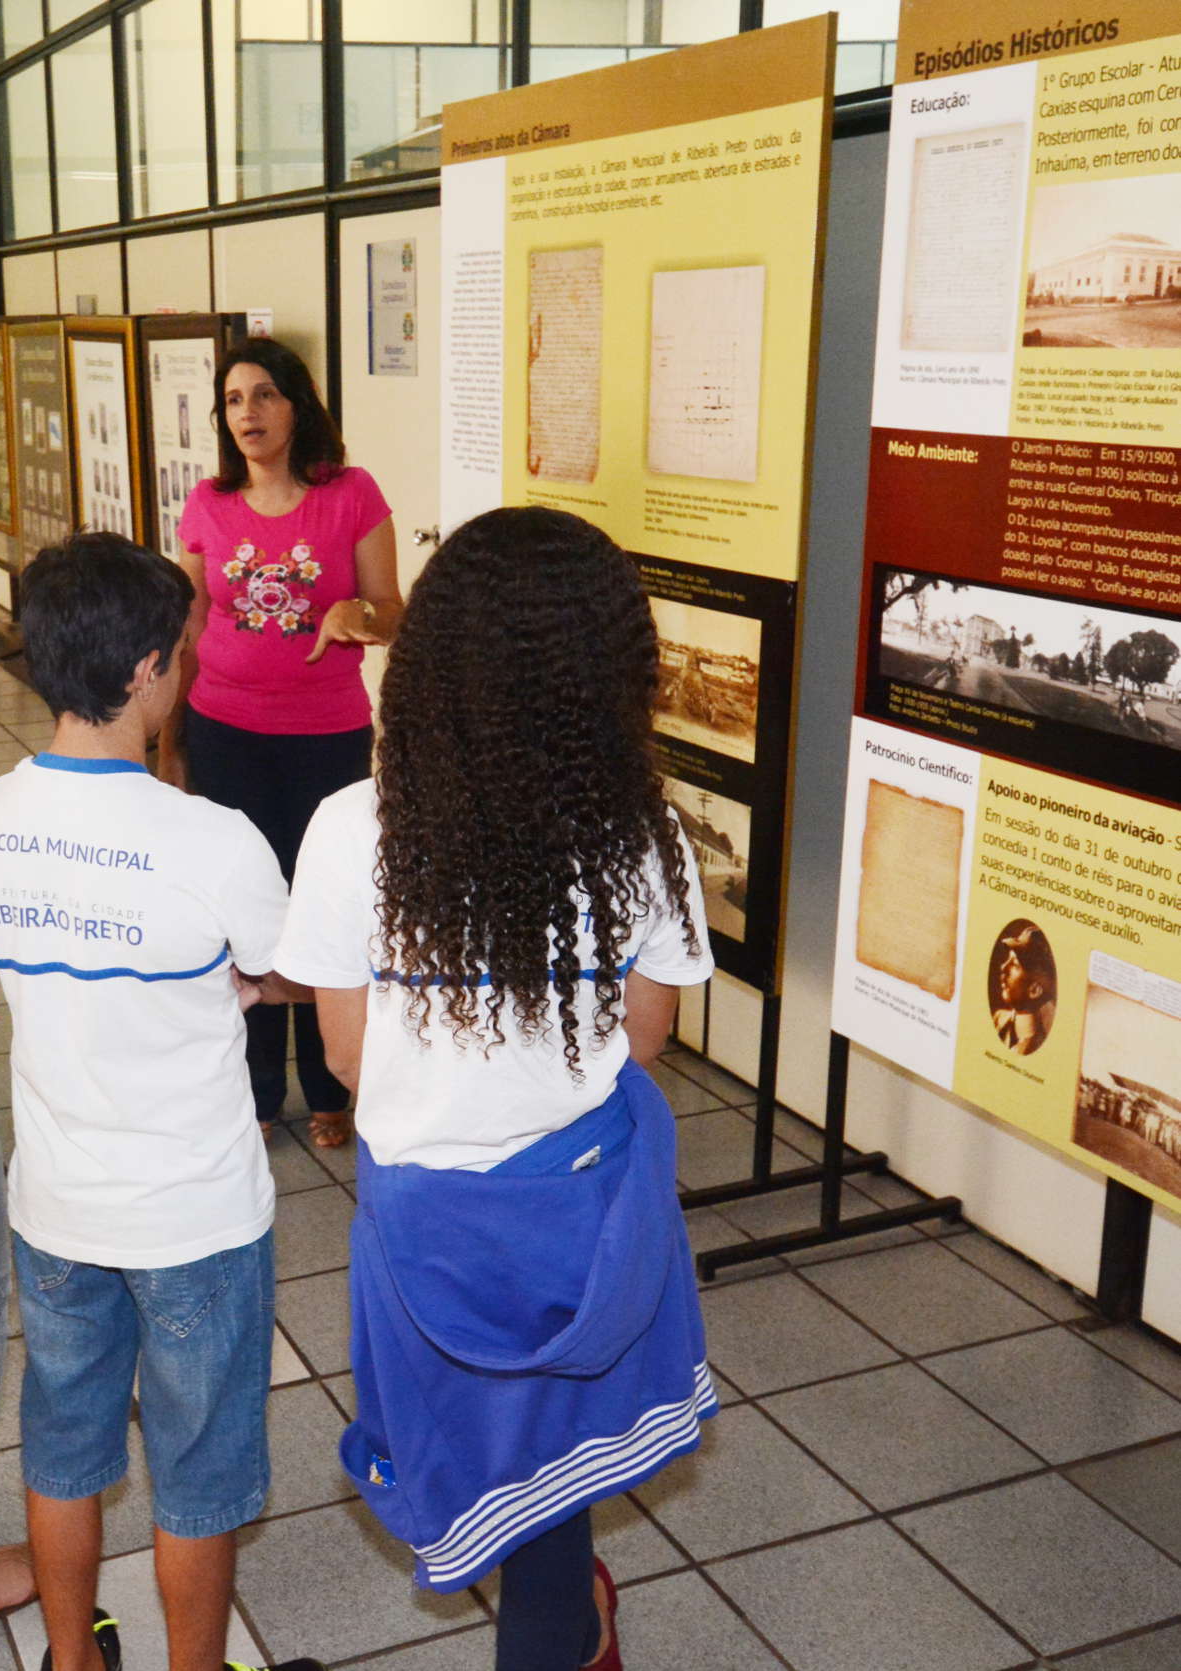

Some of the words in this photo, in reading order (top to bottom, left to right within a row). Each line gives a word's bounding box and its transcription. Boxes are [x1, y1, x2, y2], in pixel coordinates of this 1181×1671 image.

[914, 39, 1004, 80] Episódios
[1010, 18, 1120, 58] Históricos
[1059, 70, 1096, 89] Grupo
[1099, 62, 1144, 83] Escolar
[911, 91, 971, 114] Educação:
[1039, 100, 1076, 119] Caxias
[1079, 93, 1126, 115] esquina
[1128, 89, 1155, 106] com
[1157, 83, 1181, 101] Cer
[495, 133, 516, 151] atos
[517, 128, 529, 147] da
[531, 122, 571, 143] Câmara
[726, 140, 748, 154] Preto
[1036, 122, 1130, 147] Posteriormente,
[1136, 117, 1154, 135] foi
[740, 161, 752, 174] de
[1035, 152, 1090, 175] Inhaúma,
[1092, 152, 1112, 168] em
[1114, 147, 1160, 166] terreno
[887, 440, 915, 458] Meio
[917, 443, 979, 464] Ambiente:
[1012, 441, 1020, 453] O
[1022, 442, 1053, 456] Jardim
[1055, 443, 1093, 459] Público:
[1100, 447, 1118, 461] Em
[1121, 448, 1177, 467] 15/9/1900,
[1010, 458, 1048, 473] Ribeirão
[1049, 462, 1075, 476] Preto
[1076, 466, 1093, 478] em
[1095, 465, 1124, 481] 1906)
[1126, 470, 1169, 484] solicitou
[1009, 478, 1033, 491] entre
[1034, 481, 1045, 492] as
[1046, 483, 1066, 493] ruas
[1067, 481, 1105, 496] General
[1007, 493, 1033, 510] Largo
[1034, 497, 1047, 508] XV
[1048, 499, 1060, 511] de
[1061, 500, 1114, 517] Novembro.
[1008, 512, 1017, 526] O
[1018, 514, 1030, 527] Dr.
[1031, 514, 1061, 533] Loyola
[1062, 520, 1124, 539] acompanhou
[1004, 531, 1017, 543] do
[1018, 531, 1030, 545] Dr.
[1070, 540, 1092, 553] com
[1093, 540, 1129, 558] bancos
[1130, 547, 1169, 564] doados
[1003, 548, 1031, 562] doado
[1033, 552, 1054, 567] pelo
[1055, 554, 1093, 571] Coronel
[1096, 559, 1119, 576] João
[1122, 564, 1180, 585] Evangelista
[1037, 568, 1049, 583] ler
[1050, 573, 1058, 584] o
[1059, 574, 1086, 590] aviso:
[1143, 587, 1156, 601] ao
[865, 739, 917, 768] Patrocínio
[918, 756, 974, 786] Científico:
[987, 779, 1021, 801] Apoio
[1022, 791, 1037, 807] ao
[1039, 796, 1091, 823] pioneiro
[1093, 811, 1109, 828] da
[1111, 819, 1165, 846] aviação
[46, 837, 154, 871] MUNICIPAL
[984, 807, 1002, 824] Em
[1005, 814, 1041, 839] sessão
[1044, 827, 1059, 844] do
[1063, 834, 1080, 851] dia
[1084, 839, 1099, 857] 31
[1103, 847, 1119, 864] de
[1123, 854, 1173, 882] outubro
[983, 832, 1028, 858] concedia
[1032, 847, 1037, 861] 1
[1040, 851, 1072, 873] conto
[1074, 862, 1089, 879] de
[1092, 866, 1114, 888] réis
[1116, 877, 1144, 898] para
[1146, 887, 1156, 901] o
[981, 855, 1005, 876] suas
[1006, 864, 1073, 898] experiências
[1074, 886, 1106, 910] sobre
[1107, 898, 1116, 913] o
[91, 902, 146, 921] CIDADE
[979, 872, 987, 888] A
[989, 873, 1028, 904] Câmara
[1029, 892, 1074, 921] aprovou
[1075, 908, 1101, 931] esse
[1102, 917, 1145, 946] auxílio.
[74, 916, 143, 947] PRETO
